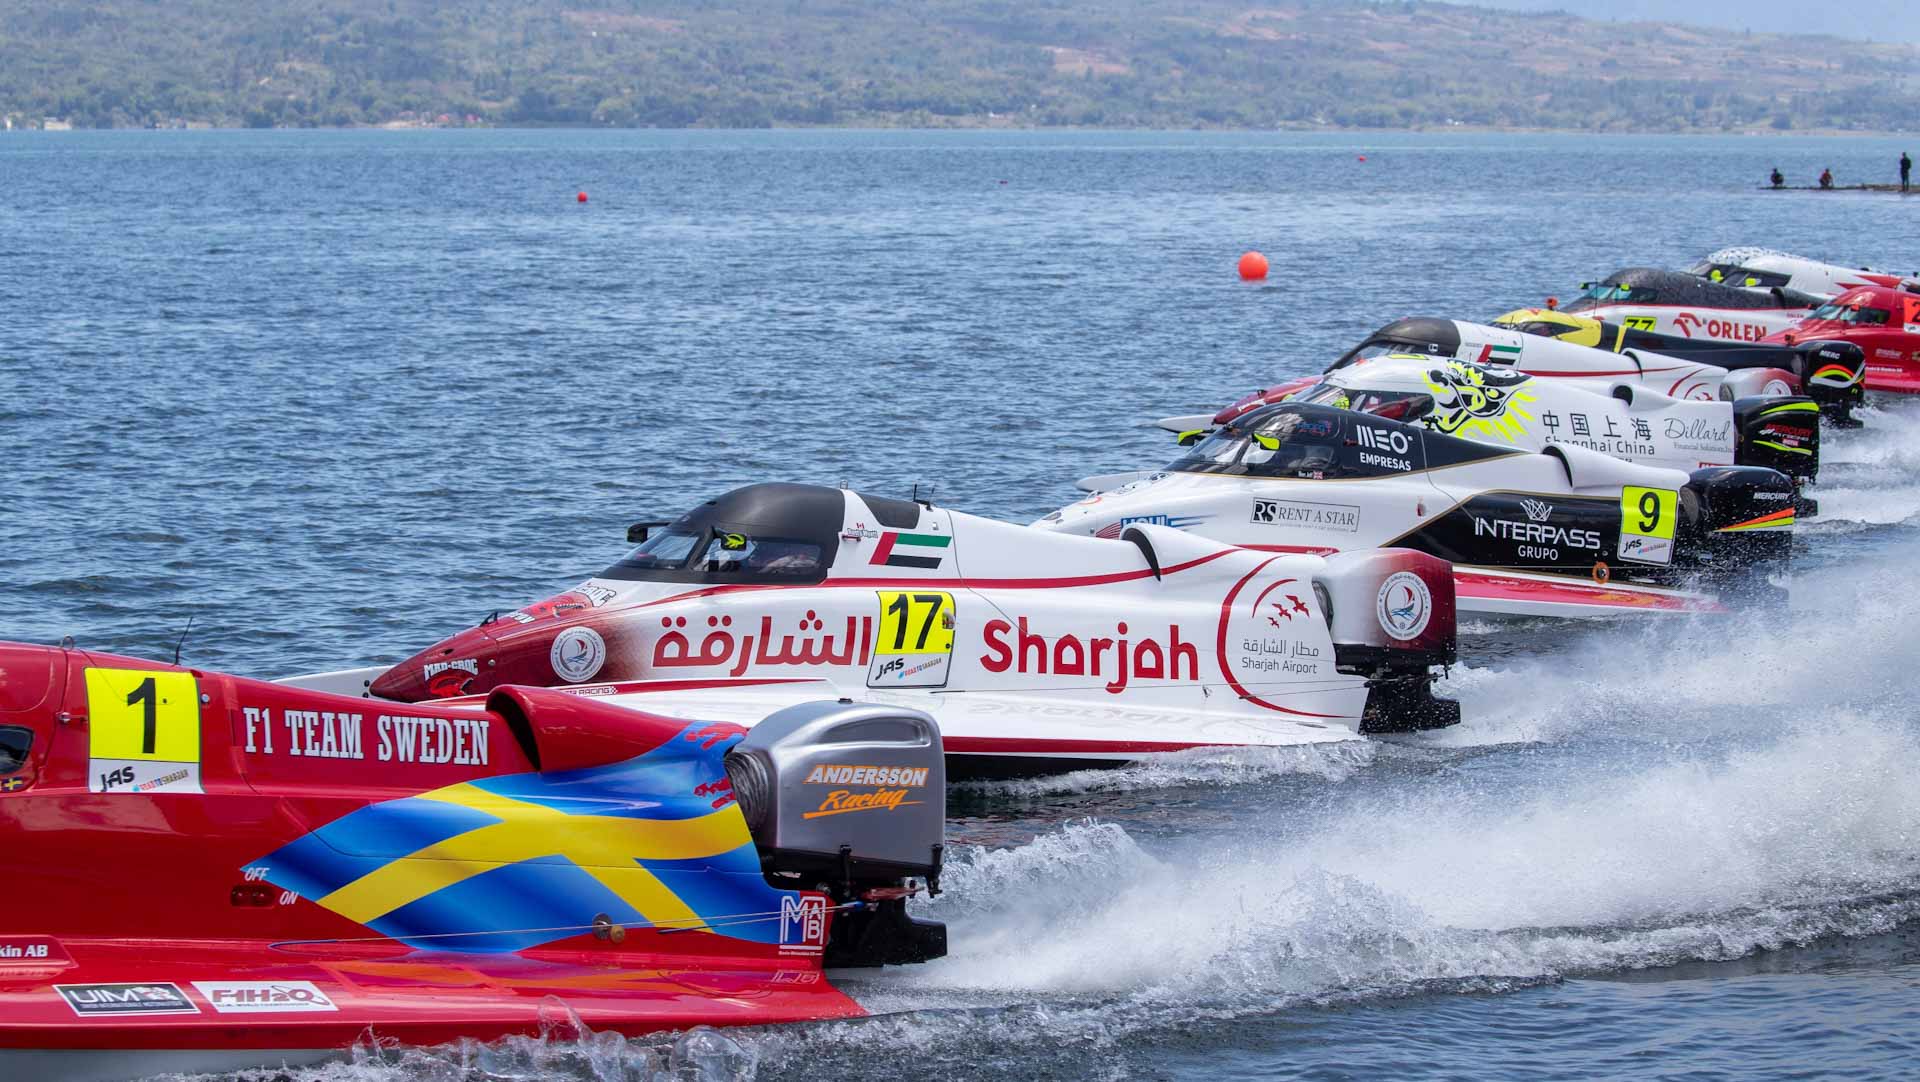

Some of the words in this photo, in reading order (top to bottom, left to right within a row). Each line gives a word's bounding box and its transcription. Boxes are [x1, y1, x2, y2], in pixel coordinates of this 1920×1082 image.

[1625, 319, 1655, 332] 77
[1707, 319, 1767, 342] ORLEN
[1542, 410, 1653, 441] 中国上海
[1664, 417, 1731, 442] Dillard
[1616, 439, 1655, 455] China
[1359, 452, 1412, 472] EMPRESAS
[1753, 492, 1791, 500] MERCURY
[1278, 506, 1313, 523] RENT
[1313, 510, 1323, 523] A
[1326, 510, 1356, 526] STAR
[1638, 491, 1660, 533] 9
[1474, 517, 1601, 550] INTERPASS
[1517, 544, 1559, 561] GRUPO
[888, 593, 944, 650] 17
[652, 609, 872, 677] الشارقة
[1243, 638, 1287, 656] الشارقة
[1291, 640, 1319, 658] مطار
[979, 616, 1199, 694] Sharjah
[1241, 657, 1280, 672] Sharjah
[1282, 660, 1318, 675] Airport
[424, 658, 479, 681] MAD-CROC
[875, 657, 905, 681] JAS
[126, 677, 157, 754] 1
[243, 707, 273, 754] F1
[284, 709, 365, 760] TEAM
[377, 714, 490, 766] SWEDEN
[100, 766, 135, 792] JAS
[805, 765, 929, 787] ANDERSSON
[818, 787, 910, 811] Racing
[244, 867, 271, 881] OFF
[279, 890, 300, 906] ON
[24, 944, 48, 957] AB
[68, 989, 141, 1003] UIM
